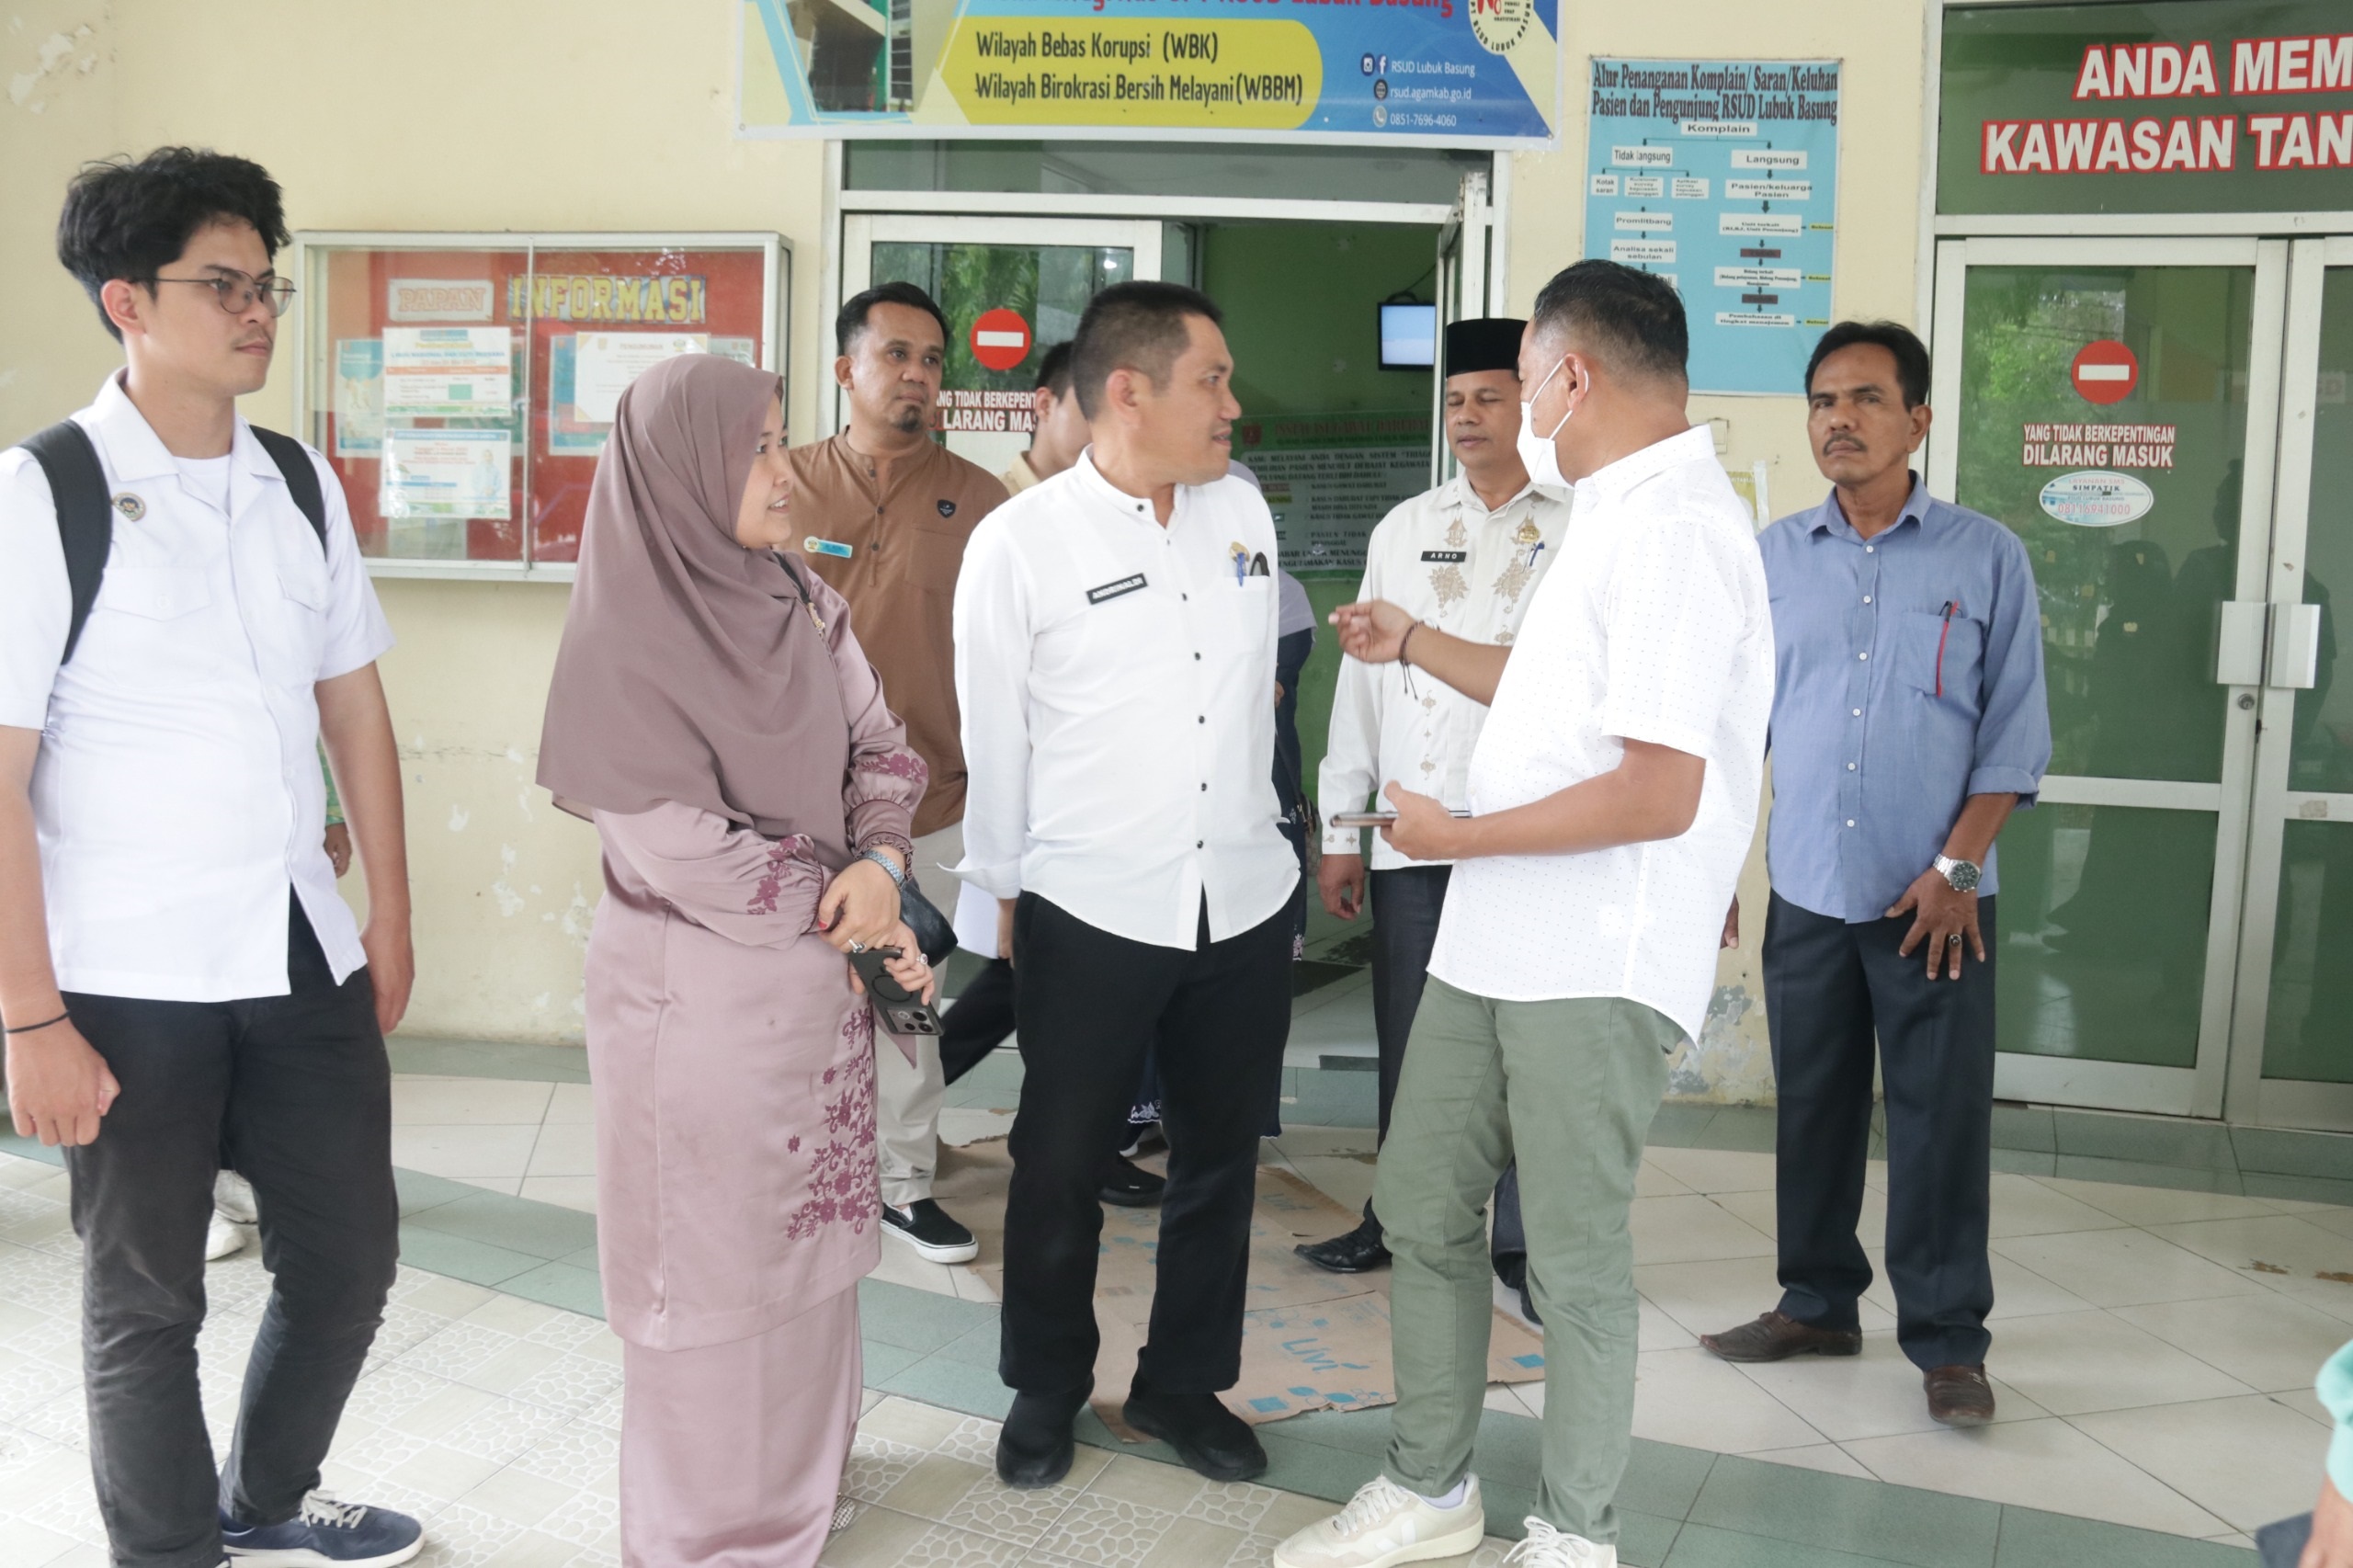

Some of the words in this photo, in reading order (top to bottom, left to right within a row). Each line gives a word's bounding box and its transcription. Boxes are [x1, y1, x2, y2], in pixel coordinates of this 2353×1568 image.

[976, 31, 1037, 63] Wilayah
[1041, 31, 1086, 58] Bebas
[1091, 31, 1151, 65] Korupsi
[1163, 30, 1219, 64] (WBK)
[1392, 61, 1415, 74] RSUD
[1416, 62, 1443, 75] Lubuk
[1444, 62, 1475, 78] Basung
[2074, 43, 2220, 98] ANDA
[2231, 35, 2353, 95] MEM
[1593, 62, 1619, 88] Alur
[1620, 63, 1688, 92] Penanganan
[1690, 64, 1752, 97] Komplain/
[974, 72, 1036, 106] Wilayah
[1040, 73, 1110, 99] Birokrasi
[1115, 74, 1165, 101] Bersih
[1169, 74, 1234, 108] Melayani
[1235, 73, 1303, 107] (WBBM)
[1390, 87, 1472, 103] rsud.agamkab.go.id
[1592, 90, 1628, 117] Pasien
[1630, 93, 1651, 118] dan
[1653, 92, 1720, 125] Pengunjung
[1722, 93, 1756, 119] RSUD
[1757, 94, 1795, 120] Lubuk
[1797, 95, 1838, 127] Basung
[1390, 114, 1457, 128] 0851-7696-4060
[1688, 124, 1751, 134] Komplain
[1982, 117, 2236, 173] KAWASAN
[2248, 112, 2353, 169] TAN
[1615, 150, 1634, 161] Tidak
[1636, 151, 1671, 164] langsung
[1746, 155, 1800, 165] Langsung
[1732, 183, 1813, 191] Pasien/keluarga
[398, 288, 486, 312] PAPAN
[511, 277, 705, 322] INFORMASI
[937, 391, 952, 407] NG
[955, 391, 982, 408] TIDAK
[983, 392, 1037, 409] BERKEPENT
[2024, 425, 2051, 442] YANG
[2052, 425, 2083, 442] TIDAK
[2084, 425, 2175, 444] BERKEPENTINGAN
[2023, 444, 2108, 466] DILARANG
[2111, 446, 2173, 467] MASUK
[2058, 503, 2131, 515] 08116941000
[1279, 559, 1333, 567] ENGUTAMAKAN
